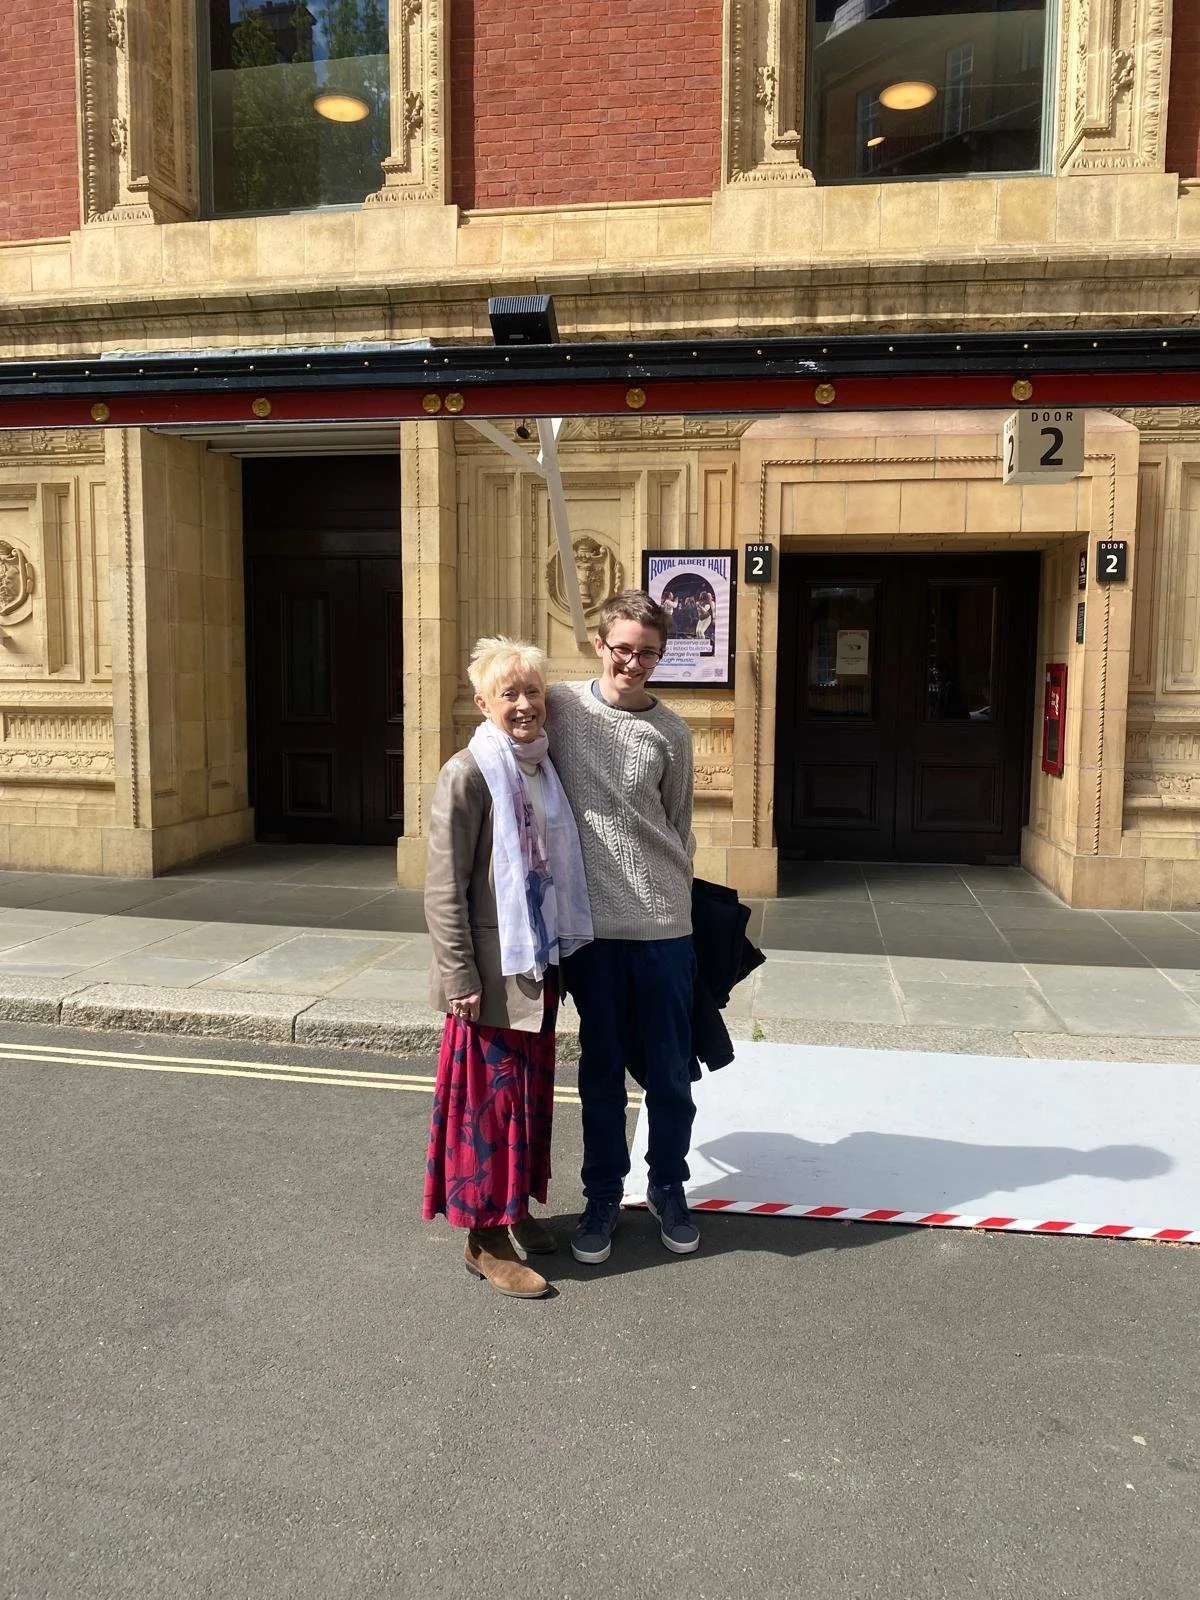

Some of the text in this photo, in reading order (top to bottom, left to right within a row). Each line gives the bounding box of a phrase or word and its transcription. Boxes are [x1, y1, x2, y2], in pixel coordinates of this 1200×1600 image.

[1031, 411, 1073, 422] DOOR
[1008, 435, 1014, 474] 2
[1040, 427, 1064, 466] 2
[650, 558, 727, 581] ROYAL ALBERT HALL
[752, 556, 764, 575] 2
[1106, 555, 1118, 573] 2
